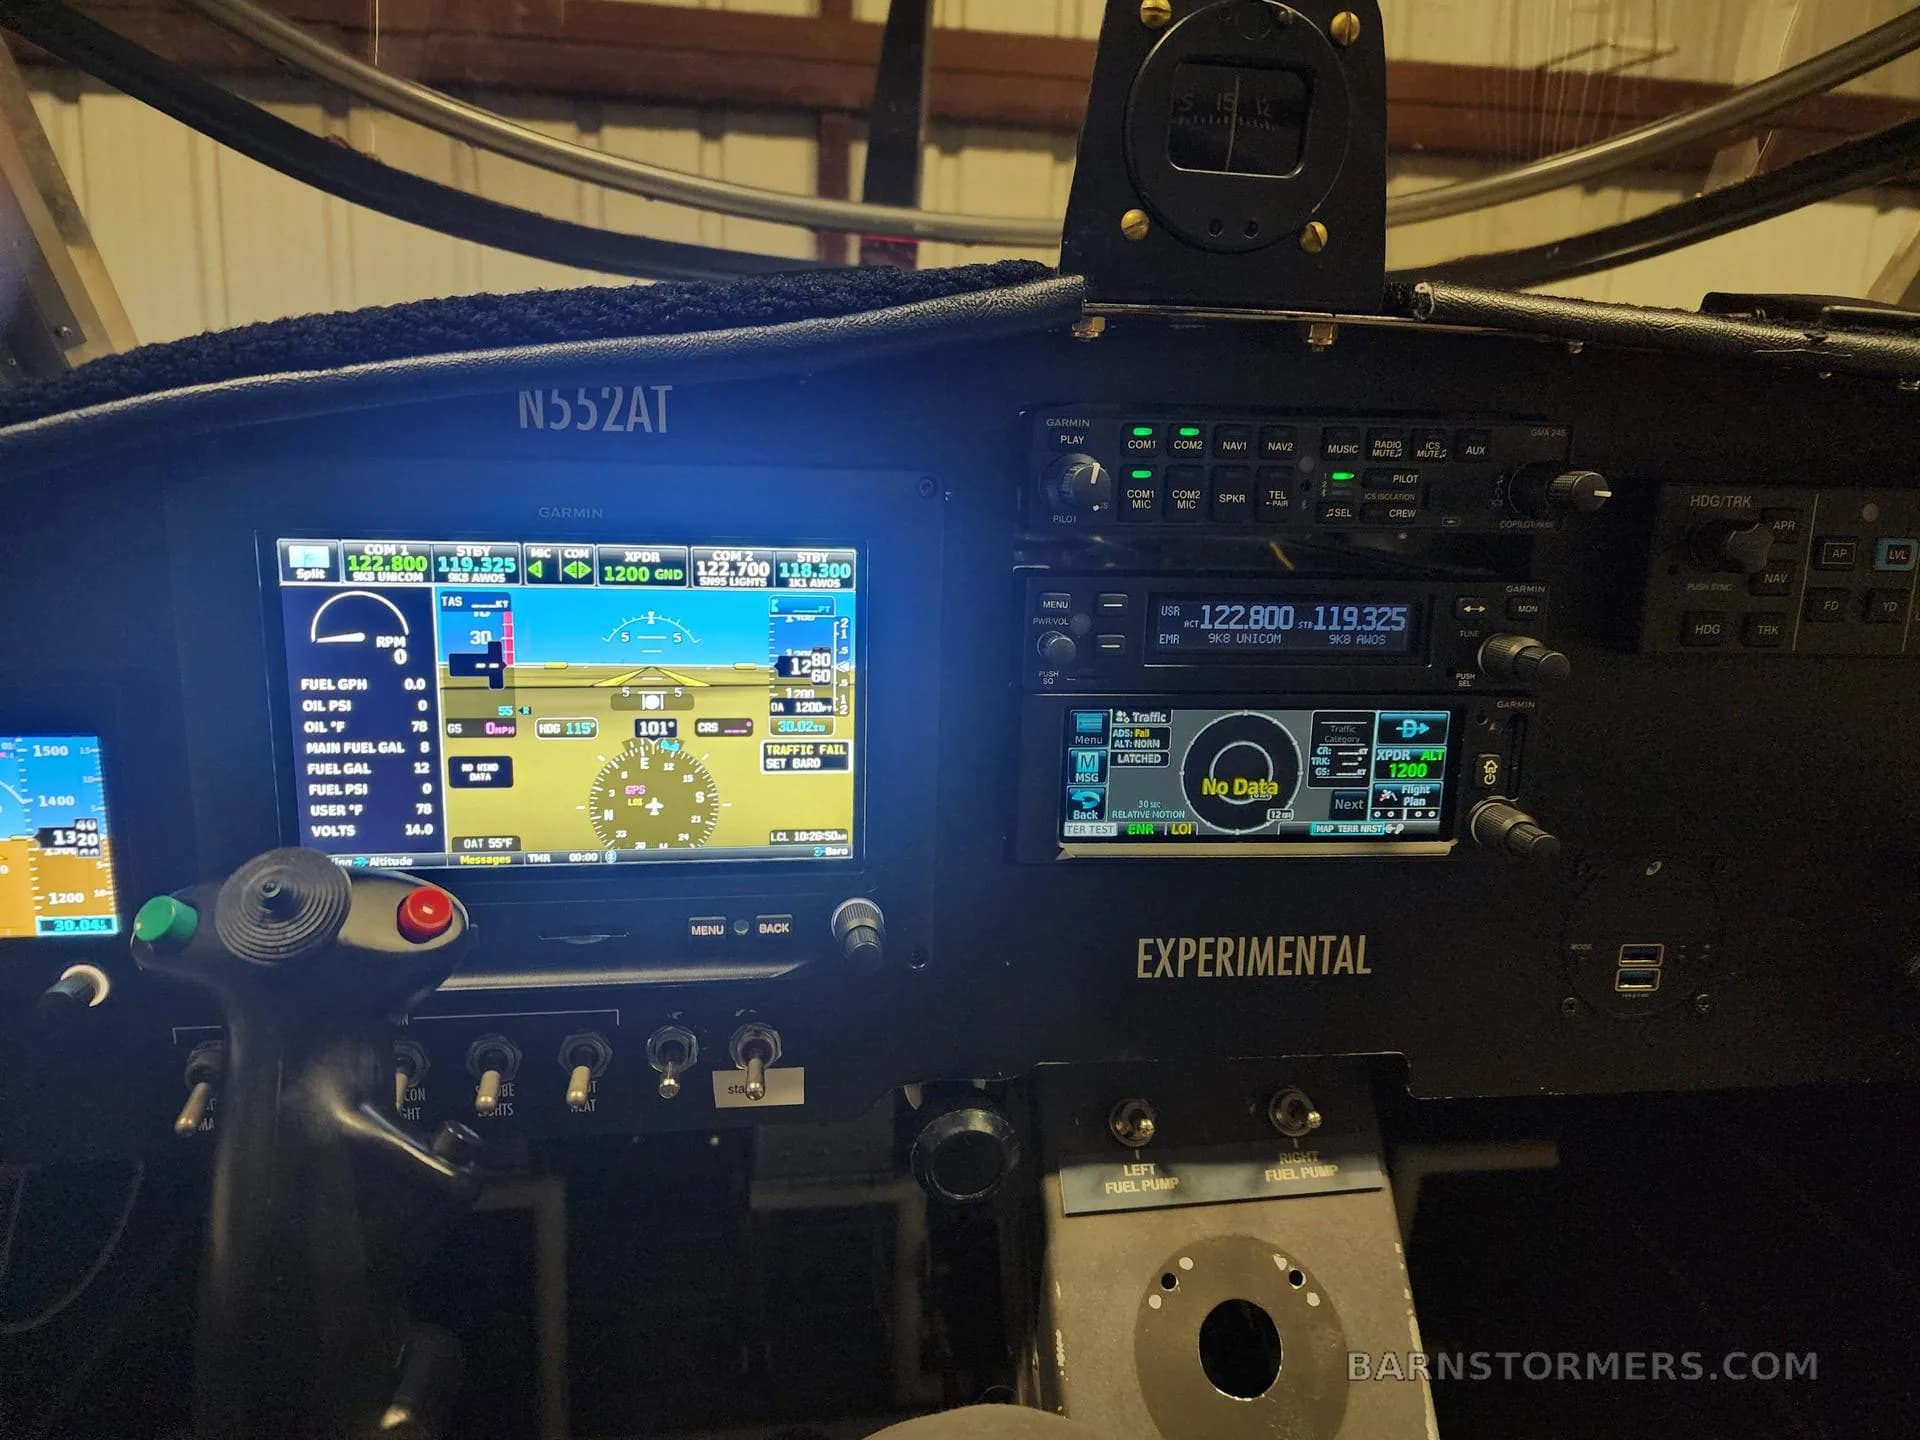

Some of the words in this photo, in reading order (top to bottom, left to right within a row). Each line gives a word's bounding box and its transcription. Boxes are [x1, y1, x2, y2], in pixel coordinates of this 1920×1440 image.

[518, 385, 673, 433] N552AT
[1046, 418, 1090, 427] GARMIN
[1060, 435, 1084, 445] PLAY
[1127, 440, 1156, 450] COM1
[1174, 440, 1203, 450] COM2
[1222, 441, 1247, 451] NAV1
[1268, 442, 1293, 452] NAV2
[1328, 444, 1359, 454] MUSIC
[1374, 441, 1402, 450] RADIO
[1425, 441, 1440, 450] ICS
[1466, 446, 1485, 455] AUX
[1372, 448, 1395, 457] MUTE
[1416, 449, 1440, 458] MUTE
[1393, 474, 1418, 484] PILOT
[1127, 490, 1155, 499] COM1
[1172, 490, 1201, 500] COM2
[1219, 494, 1246, 503] SPKR
[1269, 491, 1286, 500] TEL
[1132, 500, 1152, 509] MIC
[1177, 500, 1196, 509] MIC
[1690, 495, 1752, 507] HDG/TRK
[538, 507, 603, 519] GARMIN
[1335, 508, 1351, 518] SEL
[1389, 509, 1416, 518] CREW
[1773, 520, 1796, 530] APR
[364, 544, 396, 555] COM
[456, 545, 490, 557] STBY
[564, 549, 589, 558] COM
[1832, 549, 1847, 558] AP
[625, 551, 661, 563] XPDR
[712, 551, 743, 561] COM
[797, 552, 829, 563] STBY
[348, 555, 427, 571] 122.800
[438, 556, 516, 572] 119.325
[296, 568, 325, 580] Split
[604, 566, 650, 582] 1200
[654, 569, 683, 580] GND
[697, 561, 770, 577] 122.700
[780, 563, 851, 578] 118.300
[377, 572, 423, 582] UNICOM
[471, 573, 505, 583] AWOS
[730, 577, 767, 587] LIGHTS
[1764, 573, 1789, 584] NAV
[810, 578, 841, 588] AWOS
[1505, 585, 1545, 593] GARMIN
[442, 597, 462, 607] TAS
[1043, 601, 1068, 609] MENU
[1824, 601, 1839, 610] FD
[1882, 601, 1897, 611] YD
[1518, 605, 1538, 613] MON
[1161, 606, 1180, 616] USR
[1200, 605, 1295, 630] 122.800
[1314, 606, 1408, 631] 119.325
[1184, 620, 1199, 628] ACT
[1298, 621, 1313, 629] STB
[1695, 624, 1721, 634] HDG
[1758, 625, 1779, 635] TRK
[376, 636, 406, 648] RPM
[1159, 634, 1179, 644] EMR
[1208, 633, 1231, 643] 9K8
[1236, 633, 1282, 643] UNICOM
[1328, 634, 1351, 645] 9K8
[1357, 634, 1386, 645] AWOS
[394, 649, 407, 664] 0
[301, 678, 335, 690] FUEL
[338, 678, 367, 690] GPH
[404, 678, 426, 690] 0.0
[302, 700, 326, 712] OIL
[329, 700, 352, 712] PSI
[418, 700, 427, 711] 0
[1496, 701, 1535, 709] GARMIN
[1132, 712, 1167, 722] Traffic
[304, 721, 327, 733] OIL
[411, 721, 428, 732] 78
[448, 723, 462, 734] GS
[539, 723, 560, 734] HDG
[697, 723, 719, 733] CRS
[1331, 725, 1355, 733] Traffic
[1075, 736, 1103, 745] Menu
[1114, 739, 1133, 748] ALT:
[1134, 739, 1160, 748] NORM
[1325, 735, 1360, 743] Category
[33, 745, 69, 757] 1500
[306, 742, 340, 754] MAIN
[344, 742, 376, 754] FUEL
[378, 742, 405, 753] GAL
[767, 745, 813, 755] TRAFFIC
[820, 745, 846, 755] FAIL
[1117, 754, 1161, 763] LATCHED
[1377, 750, 1410, 760] XPDR
[1421, 751, 1444, 760] ALT
[307, 763, 341, 775] FUEL
[343, 763, 372, 774] GAL
[414, 762, 430, 774] 12
[766, 759, 786, 769] SET
[793, 758, 820, 769] BARO
[1389, 764, 1427, 777] 1200
[469, 773, 491, 781] DATA
[1075, 773, 1099, 782] MSG
[309, 784, 342, 796] FUEL
[345, 784, 368, 795] PSI
[422, 783, 432, 794] 0
[625, 785, 647, 795] GPS
[1202, 778, 1228, 795] No
[1233, 778, 1278, 795] Data
[1401, 785, 1430, 795] Flight
[39, 795, 75, 807] 1400
[1138, 800, 1149, 808] 30
[1335, 799, 1364, 809] Next
[1403, 796, 1426, 806] Plan
[310, 805, 346, 816] USER
[416, 803, 432, 815] 78
[1112, 810, 1150, 818] RELATIVE
[1152, 810, 1185, 818] MOTION
[1073, 810, 1098, 820] Back
[311, 825, 356, 837] VOLTS
[405, 824, 433, 835] 14.0
[1066, 825, 1086, 833] TER
[1090, 825, 1113, 833] TEST
[1127, 824, 1154, 835] ENR
[1171, 824, 1192, 835] LOI
[771, 832, 789, 841] LCL
[464, 839, 483, 848] OAT
[826, 847, 848, 855] Baro
[369, 857, 412, 866] Altitude
[460, 855, 511, 866] Messages
[529, 854, 550, 863] TMR
[569, 852, 597, 862] 00:00
[49, 893, 84, 905] 1200
[691, 925, 724, 936] MENU
[759, 923, 790, 934] BACK
[1137, 935, 1372, 978] EXPERIMENTAL
[1279, 1152, 1320, 1164] RIGHT
[1123, 1164, 1155, 1176] LEFT
[1264, 1168, 1299, 1182] FUEL
[1301, 1165, 1339, 1178] PUMP
[1105, 1181, 1140, 1194] FUEL
[1142, 1178, 1180, 1191] PUMP
